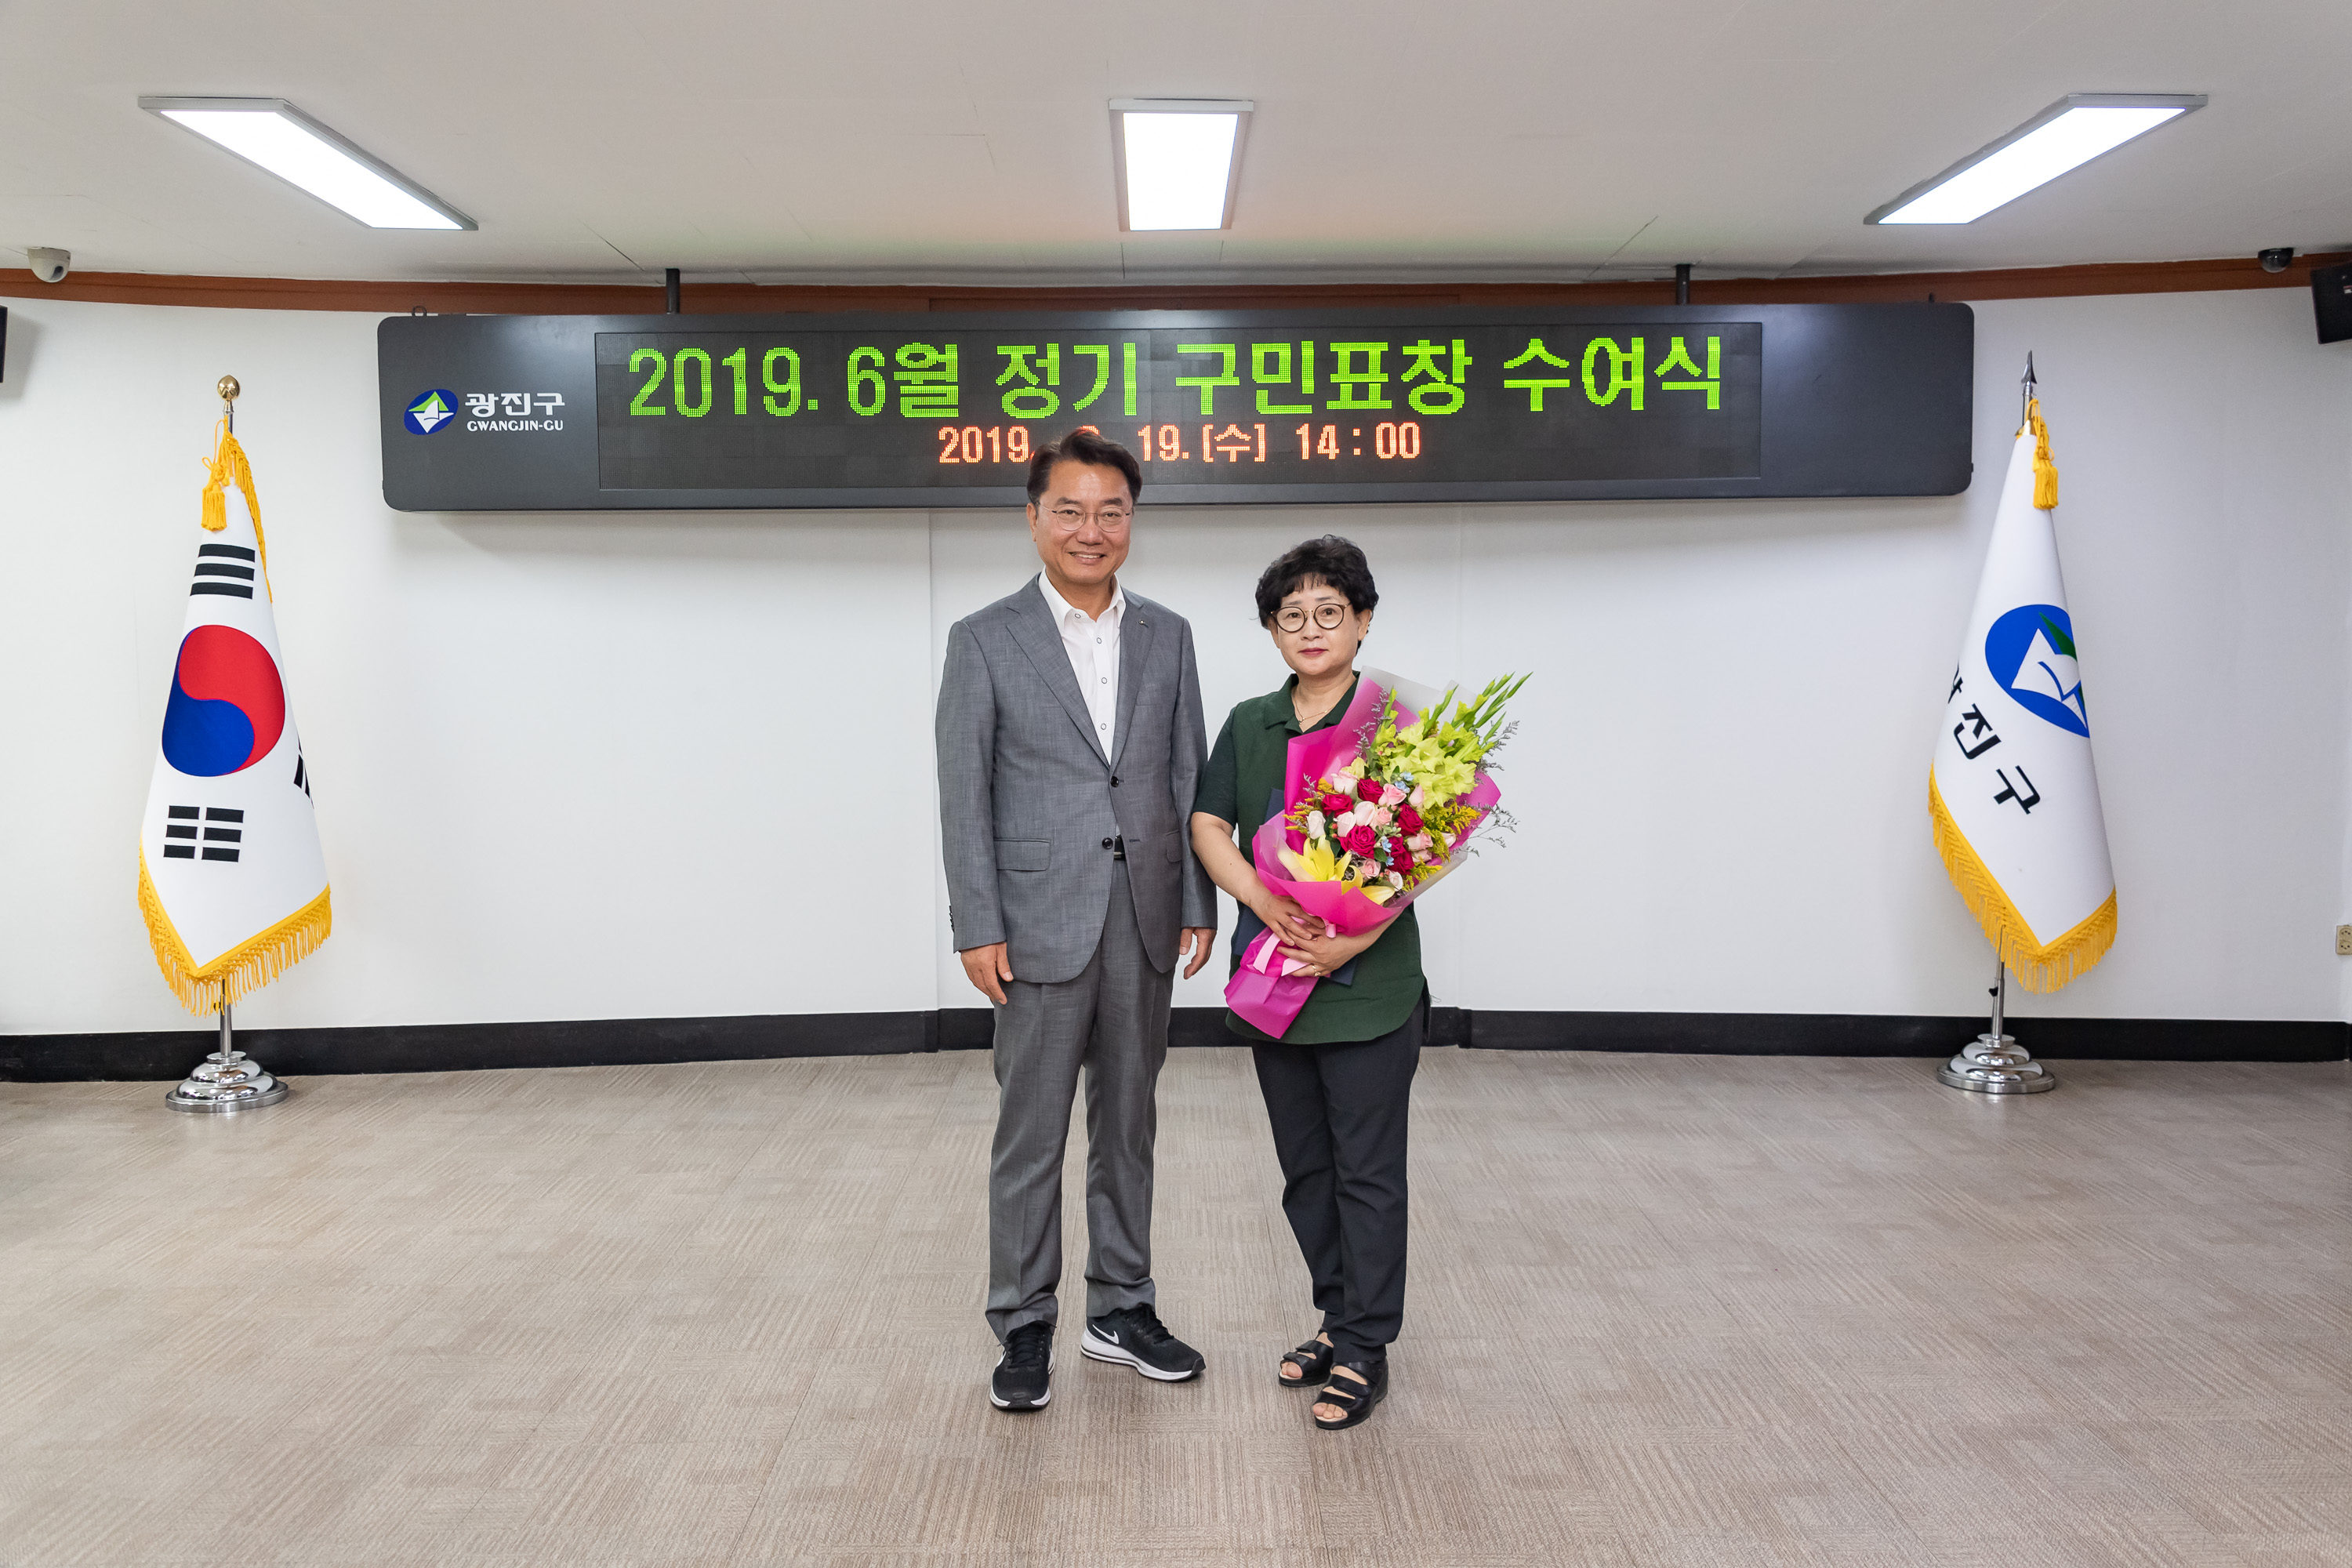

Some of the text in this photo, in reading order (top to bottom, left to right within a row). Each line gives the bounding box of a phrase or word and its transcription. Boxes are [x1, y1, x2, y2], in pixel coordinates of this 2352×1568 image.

[629, 336, 1721, 419] 2019. 6월 정기 구민표창 수여식
[465, 392, 565, 418] 광진구
[466, 419, 564, 432] GWANGJIN-GU
